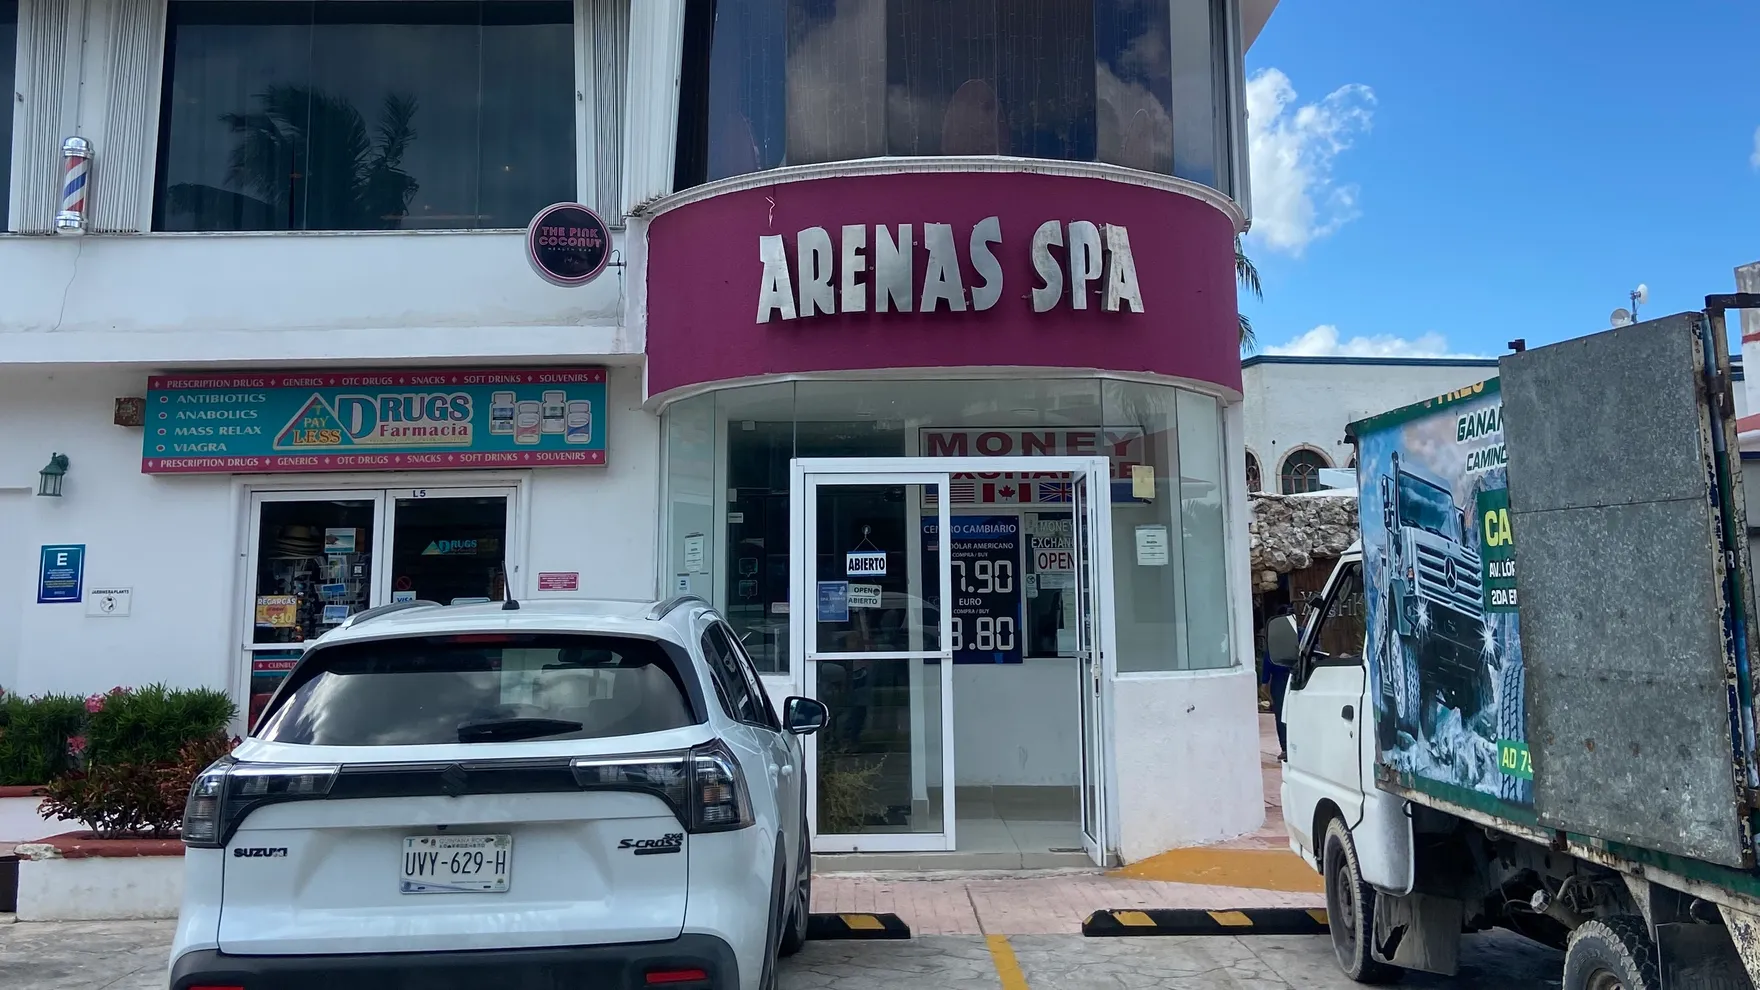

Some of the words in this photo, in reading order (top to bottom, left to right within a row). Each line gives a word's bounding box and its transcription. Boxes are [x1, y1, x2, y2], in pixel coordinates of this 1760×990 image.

[542, 226, 565, 236] THE
[569, 227, 598, 238] PINK
[538, 236, 601, 248] COCONUT
[756, 216, 1003, 324] ARENAS
[1031, 220, 1145, 313] SPA
[167, 379, 231, 389] PRESCRIPTION
[233, 378, 264, 388] DRUGS
[283, 377, 323, 387] GENERICS
[342, 377, 360, 386] OTC
[362, 376, 393, 386] DRUGS
[411, 375, 445, 385] SNACKS
[463, 375, 486, 384] SOFT
[488, 374, 521, 384] DRINKS
[539, 373, 588, 383] SOUVENIRS
[176, 393, 266, 404] ANTIBIOTICS
[175, 410, 258, 420] ANABOLICS
[337, 393, 472, 440] DRUGS
[304, 416, 330, 428] PAY
[174, 426, 214, 436] MASS
[219, 425, 262, 436] RELAX
[380, 423, 469, 437] Farmacia
[293, 428, 342, 445] LESS
[173, 442, 227, 452] VIAGRA
[927, 431, 1140, 457] MONEY
[277, 456, 319, 466] GENERICS
[337, 456, 355, 465] OTC
[358, 455, 388, 464] DRUGS
[407, 454, 441, 463] SNACKS
[459, 453, 483, 463] SOFT
[484, 452, 518, 462] DRINKS
[536, 451, 586, 461] SOUVENIRS
[160, 458, 225, 468] PRESCRIPTION
[227, 457, 259, 467] DRUGS
[923, 525, 961, 534] CERO
[962, 524, 1017, 534] CAMBIARIO
[973, 542, 1014, 550] AMERICANO
[1031, 537, 1074, 548] EXCHAN
[57, 552, 68, 566] E
[848, 557, 885, 571] ABIERTO
[1038, 552, 1075, 570] OPEN
[1489, 561, 1501, 578] AV.
[853, 586, 873, 594] OPEN
[848, 597, 878, 605] ABIERTO
[958, 598, 982, 606] EURO
[1491, 589, 1508, 605] 2DA
[271, 612, 293, 625] $10
[1502, 746, 1517, 769] AD
[662, 833, 684, 841] SX4
[617, 838, 682, 849] S-CROSS
[233, 847, 288, 858] SUZUKI
[405, 850, 506, 876] UVY-629-H
